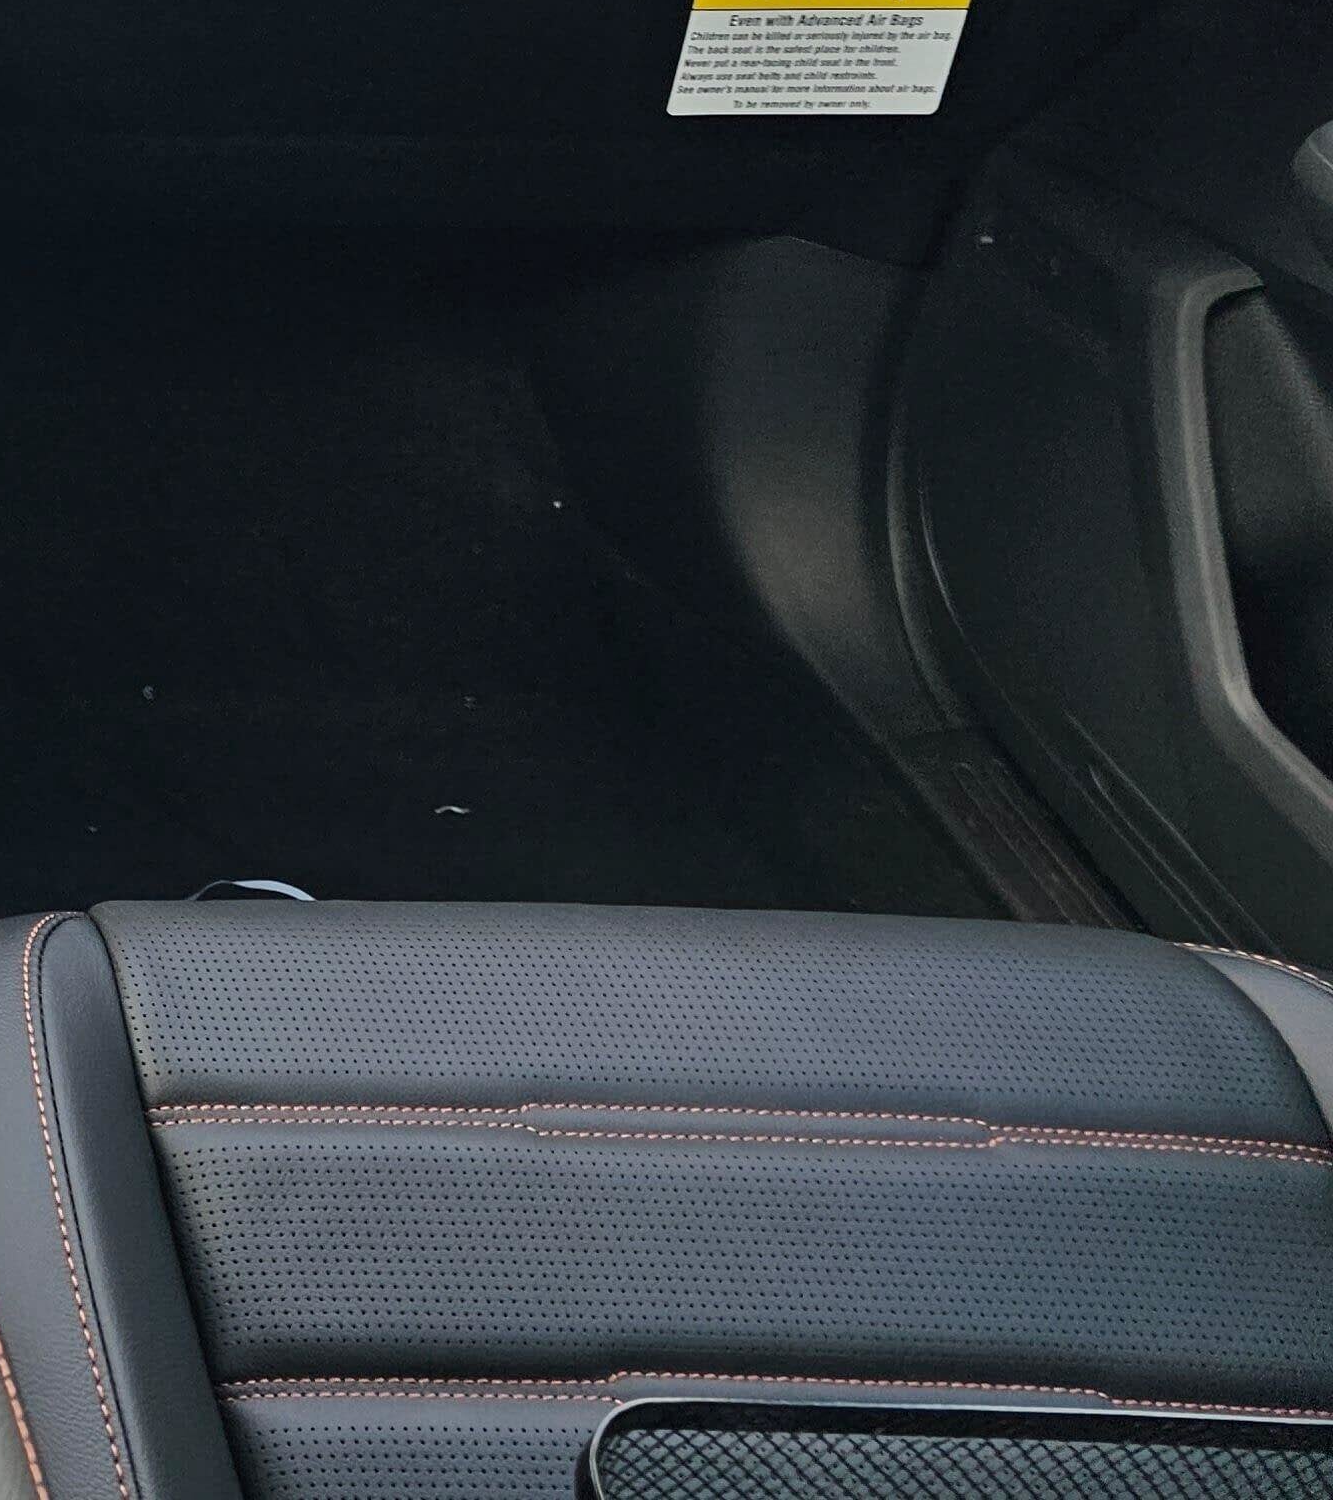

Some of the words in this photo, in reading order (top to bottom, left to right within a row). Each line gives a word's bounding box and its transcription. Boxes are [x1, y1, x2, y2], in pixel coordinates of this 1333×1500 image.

[729, 15, 761, 26] Even
[766, 15, 793, 26] with
[796, 14, 862, 26] Advanced
[867, 14, 886, 25] Air
[889, 14, 923, 27] Bags
[751, 32, 763, 40] be
[766, 32, 791, 40] killed
[851, 32, 885, 41] injured
[900, 31, 914, 40] the
[916, 31, 931, 40] air
[688, 45, 704, 54] The
[707, 45, 728, 54] back
[732, 46, 753, 54] seat
[765, 45, 781, 54] the
[783, 45, 812, 54] safest
[813, 45, 841, 55] place
[843, 45, 857, 54] for
[794, 59, 818, 67] child
[820, 59, 841, 67] seat
[843, 59, 853, 67] in
[855, 59, 870, 67] the
[681, 73, 713, 82] Always
[783, 72, 802, 80] and
[804, 72, 828, 80] child
[677, 86, 694, 94] See
[734, 85, 769, 93] manual
[771, 85, 784, 93] for
[813, 85, 866, 93] information
[868, 85, 894, 93] about
[896, 85, 910, 93] air
[733, 100, 743, 108] To
[745, 100, 757, 108] be
[760, 100, 802, 109] removed
[804, 100, 814, 109] by
[817, 100, 847, 108] owner
